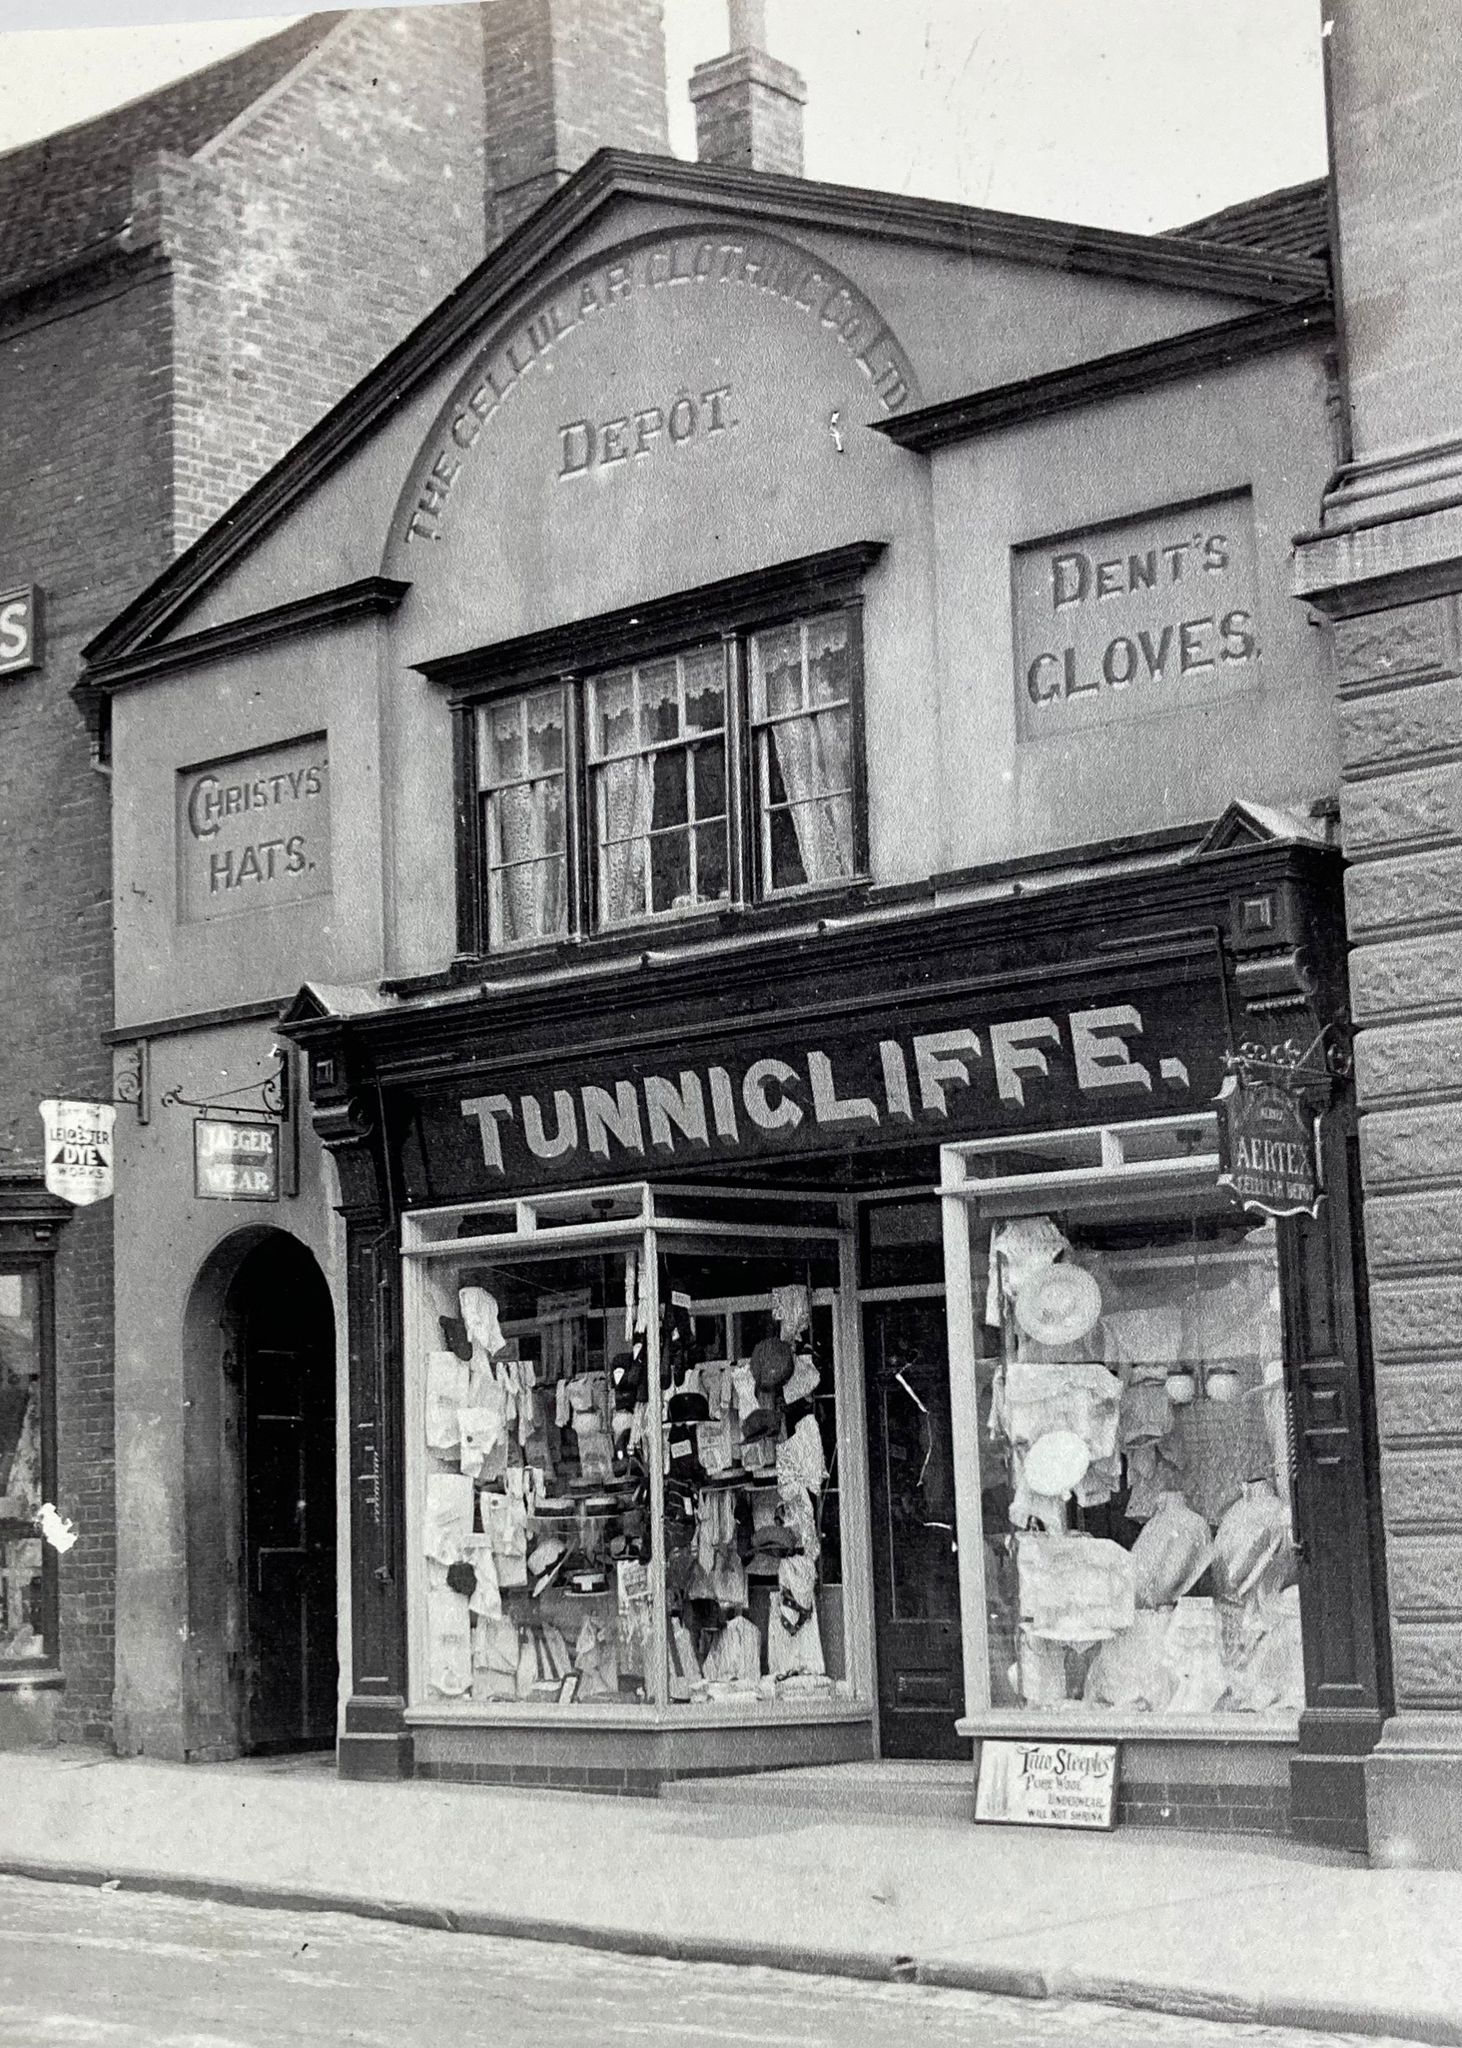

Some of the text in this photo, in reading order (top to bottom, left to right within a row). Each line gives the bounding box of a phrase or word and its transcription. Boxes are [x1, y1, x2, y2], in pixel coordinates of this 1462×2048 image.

[404, 449, 462, 544] THE
[452, 259, 633, 450] CELLULAR
[1051, 533, 1229, 611] DENT'S
[1027, 610, 1262, 705] GLOVES.
[210, 836, 316, 894] HATS.
[461, 1004, 1190, 1174] TUNNICLIFFE.
[50, 1126, 110, 1145] LEICETER
[201, 1126, 273, 1156] JAEGER
[64, 1145, 99, 1166] DYE
[1236, 1136, 1313, 1176] AERTEX
[204, 1168, 270, 1192] WEAR
[1016, 1745, 1114, 1779] Two Steeples
[1051, 1808, 1067, 1819] NOT
